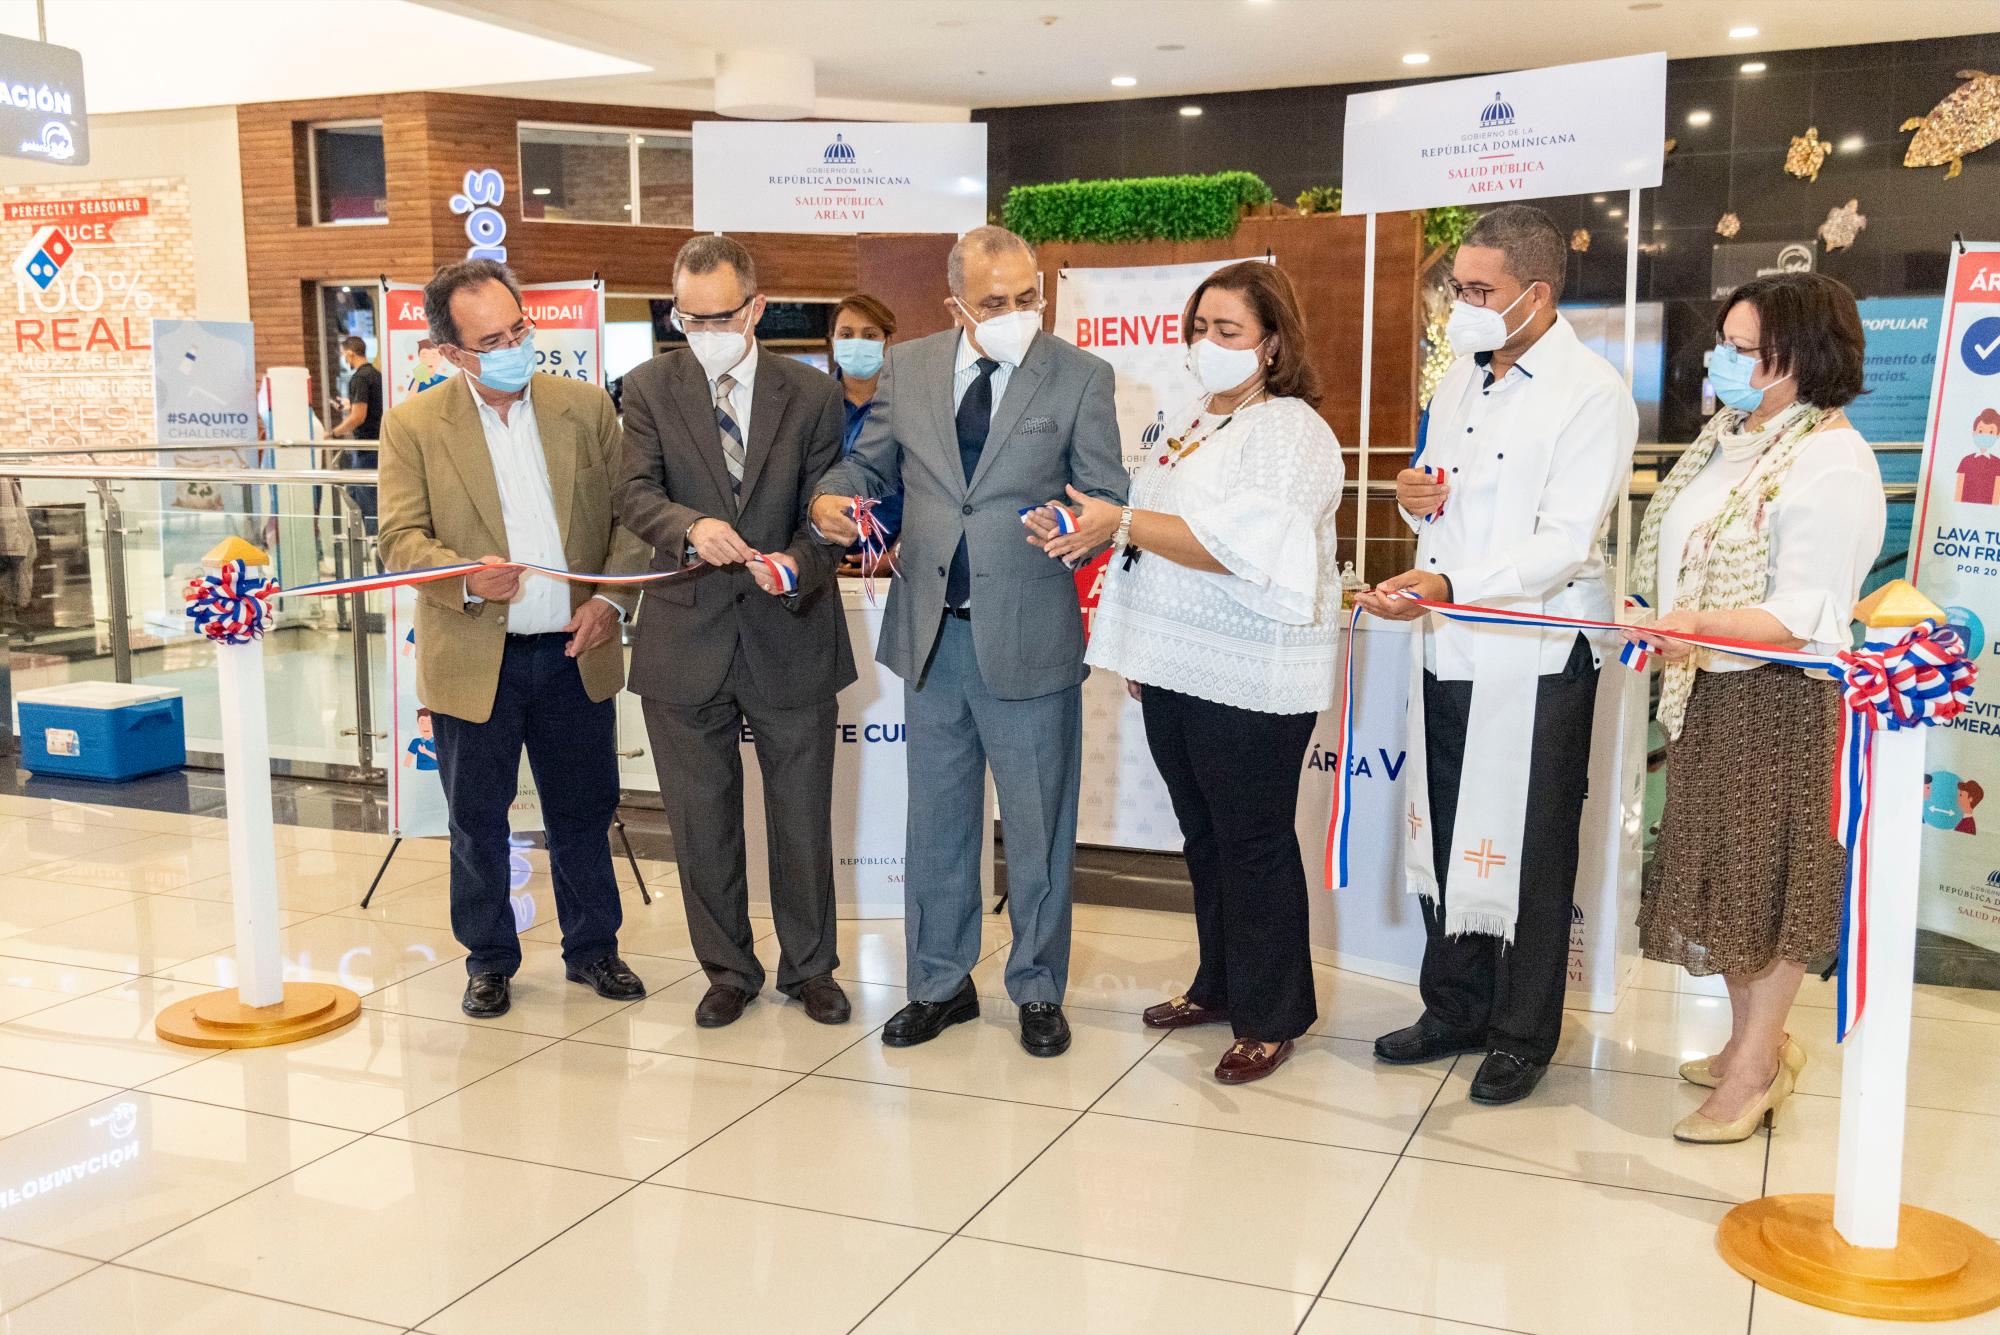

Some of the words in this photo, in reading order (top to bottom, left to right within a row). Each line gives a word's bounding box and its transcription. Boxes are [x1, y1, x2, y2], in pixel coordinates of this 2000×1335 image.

[1461, 128, 1504, 141] GOBIERNO
[1508, 127, 1519, 135] DE
[1421, 142, 1488, 158] REPÚBLICA
[1493, 133, 1576, 151] DOMINICANA
[1448, 166, 1488, 179] SALUD
[1492, 159, 1544, 176] PÚBLICA
[768, 174, 832, 185] REPÚBLICA
[836, 176, 911, 185] DOMINICANA
[1467, 181, 1504, 194] AREA
[1509, 178, 1523, 190] VI
[11, 203, 75, 218] PERFECTLY
[79, 199, 141, 215] SEASONED
[795, 197, 832, 206] SALUD
[836, 195, 884, 206] PÚBLICA
[815, 210, 848, 220] AREA
[853, 210, 865, 219] VI
[14, 316, 153, 353] REAL
[1076, 314, 1185, 348] BIENVE
[573, 350, 588, 366] Y
[167, 412, 249, 427] #SAQUITO
[168, 427, 249, 439] CHALLENGE
[1936, 526, 1980, 544] LAVA
[1933, 542, 1970, 559] CON
[1957, 564, 1980, 575] POR
[1984, 567, 1998, 577] 20
[1307, 743, 1373, 779] ÁRA
[840, 857, 897, 865] REPÚBLICA
[1939, 883, 1991, 903] REPÚBLICA
[1958, 906, 1989, 921] SALUD
